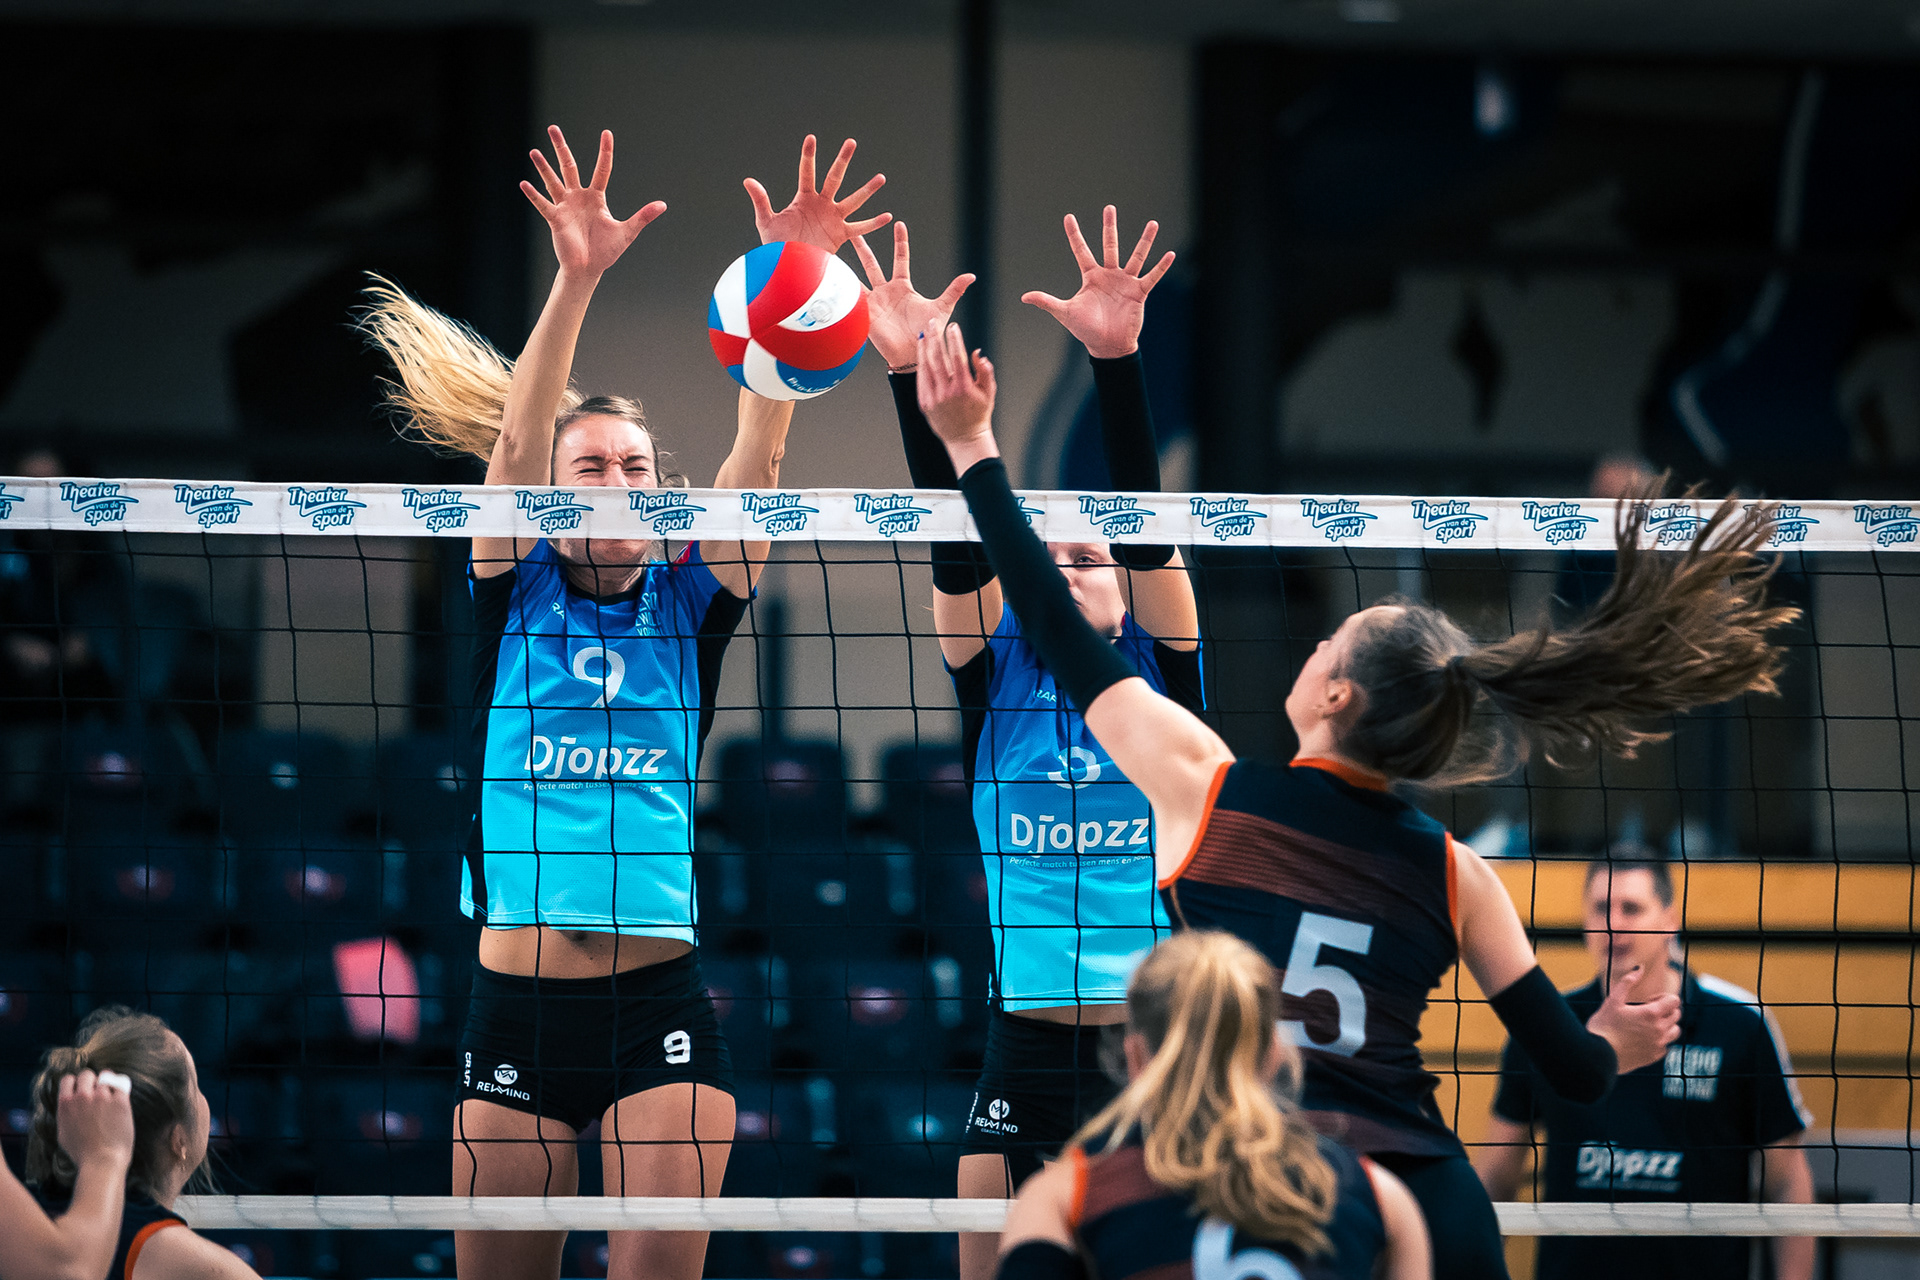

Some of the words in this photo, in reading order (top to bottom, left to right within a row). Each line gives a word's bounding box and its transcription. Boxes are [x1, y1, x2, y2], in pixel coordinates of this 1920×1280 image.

[59, 482, 122, 505] Theater
[109, 500, 120, 508] de
[174, 485, 236, 508] Theater
[288, 487, 350, 510] Theater
[401, 489, 464, 512] Theater
[515, 490, 577, 514] Theater
[628, 492, 690, 515] Theater
[741, 493, 802, 516] Theater
[86, 505, 126, 525] sport
[565, 508, 575, 516] de
[790, 510, 800, 518] de
[854, 494, 915, 517] Theater
[1078, 496, 1139, 519] Theater
[1189, 498, 1250, 521] Theater
[1300, 499, 1361, 522] Theater
[1411, 501, 1472, 524] Theater
[1522, 502, 1582, 525] Theater
[1853, 505, 1913, 527] Theater
[200, 508, 240, 527] sport
[314, 510, 354, 529] sport
[428, 512, 468, 531] sport
[541, 513, 581, 533] sport
[654, 514, 694, 534] sport
[767, 515, 806, 535] sport
[880, 516, 920, 535] sport
[1104, 518, 1143, 538] sport
[1215, 520, 1254, 539] sport
[1326, 521, 1365, 541] sport
[1437, 523, 1476, 542] sport
[1547, 524, 1586, 544] sport
[1879, 527, 1917, 546] sport
[573, 647, 626, 708] 9
[524, 735, 668, 779] Djopzz
[524, 783, 556, 791] Pefecte
[562, 782, 584, 790] match
[1011, 813, 1149, 858] Djopzz
[1009, 856, 1040, 867] Perfecte
[1098, 858, 1119, 866] mens
[1275, 911, 1374, 1058] 5
[663, 1030, 691, 1064] 9
[464, 1051, 472, 1087] CRAFT
